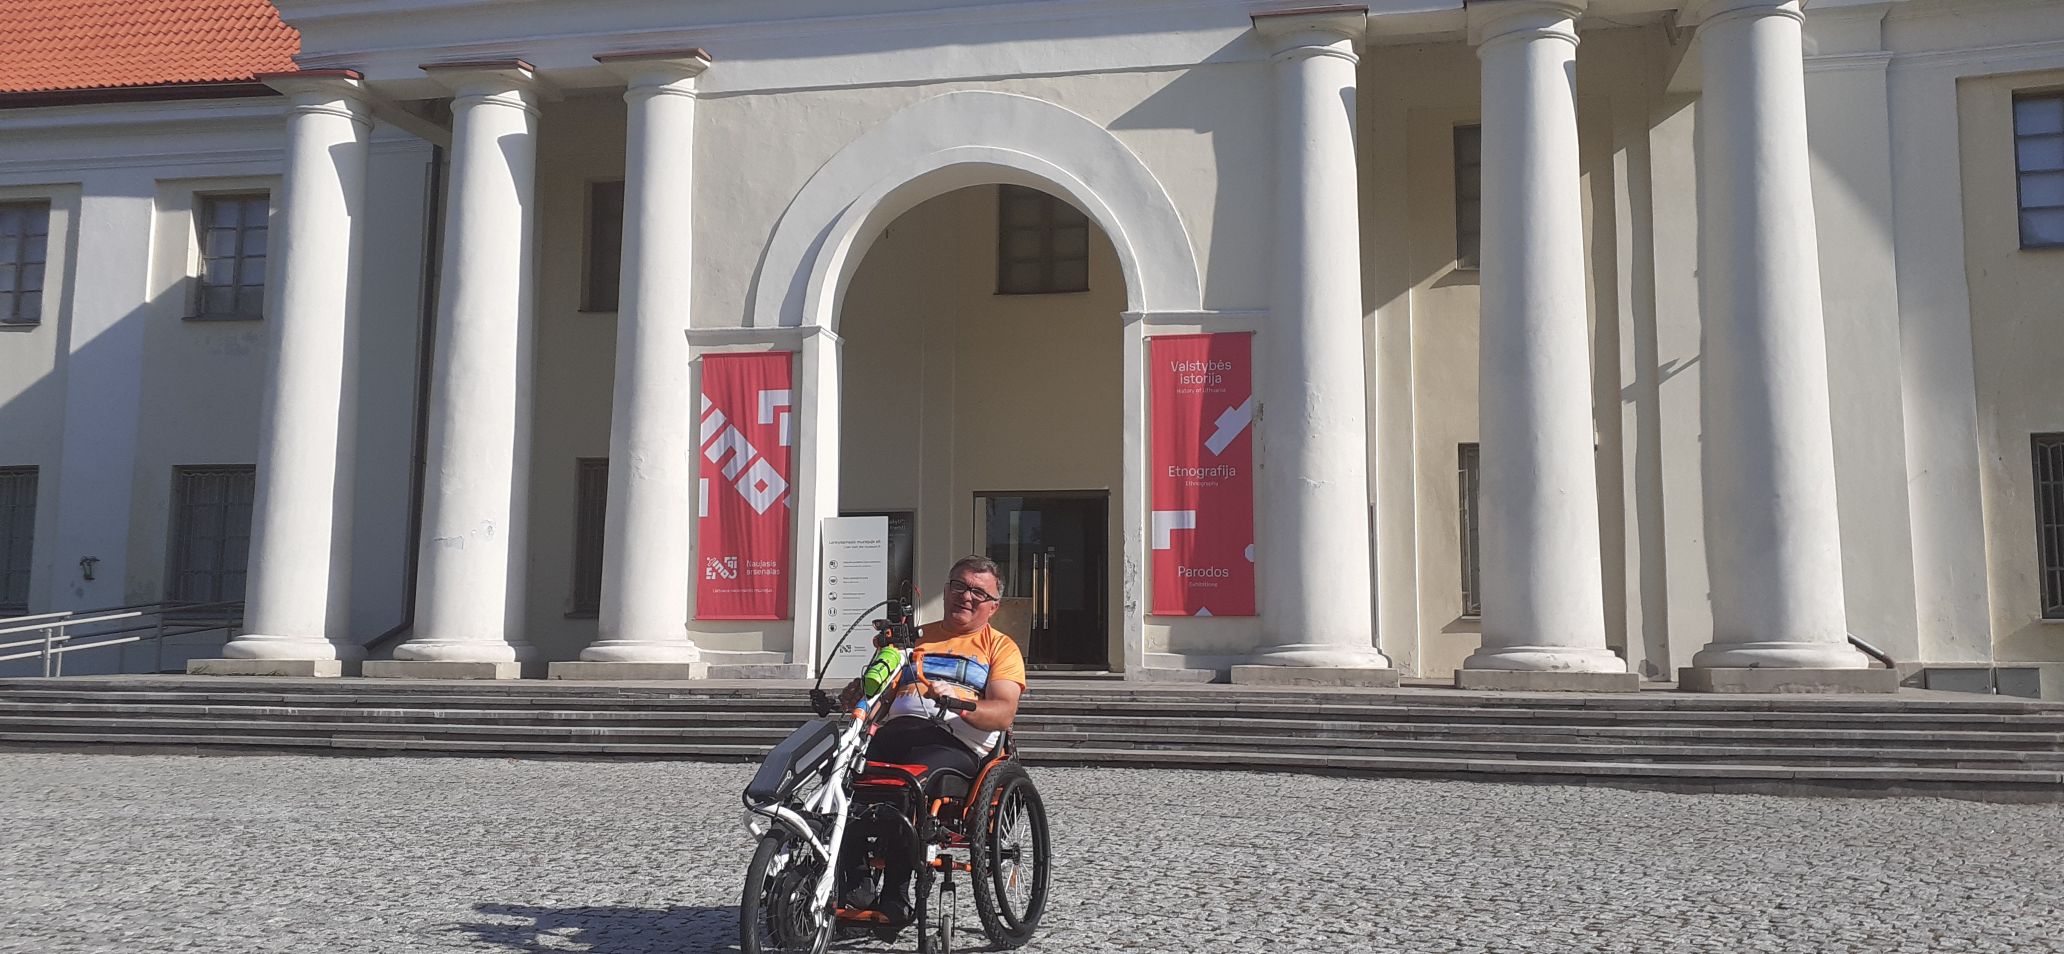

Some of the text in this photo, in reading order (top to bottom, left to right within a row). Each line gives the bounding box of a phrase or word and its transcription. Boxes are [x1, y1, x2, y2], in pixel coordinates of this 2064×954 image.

[1170, 360, 1232, 373] Valstybės
[1180, 373, 1222, 386] istorija
[1168, 465, 1236, 479] Etnografija
[746, 560, 777, 569] Naujasis
[746, 568, 780, 576] arsenalas
[1177, 566, 1229, 577] Parodos
